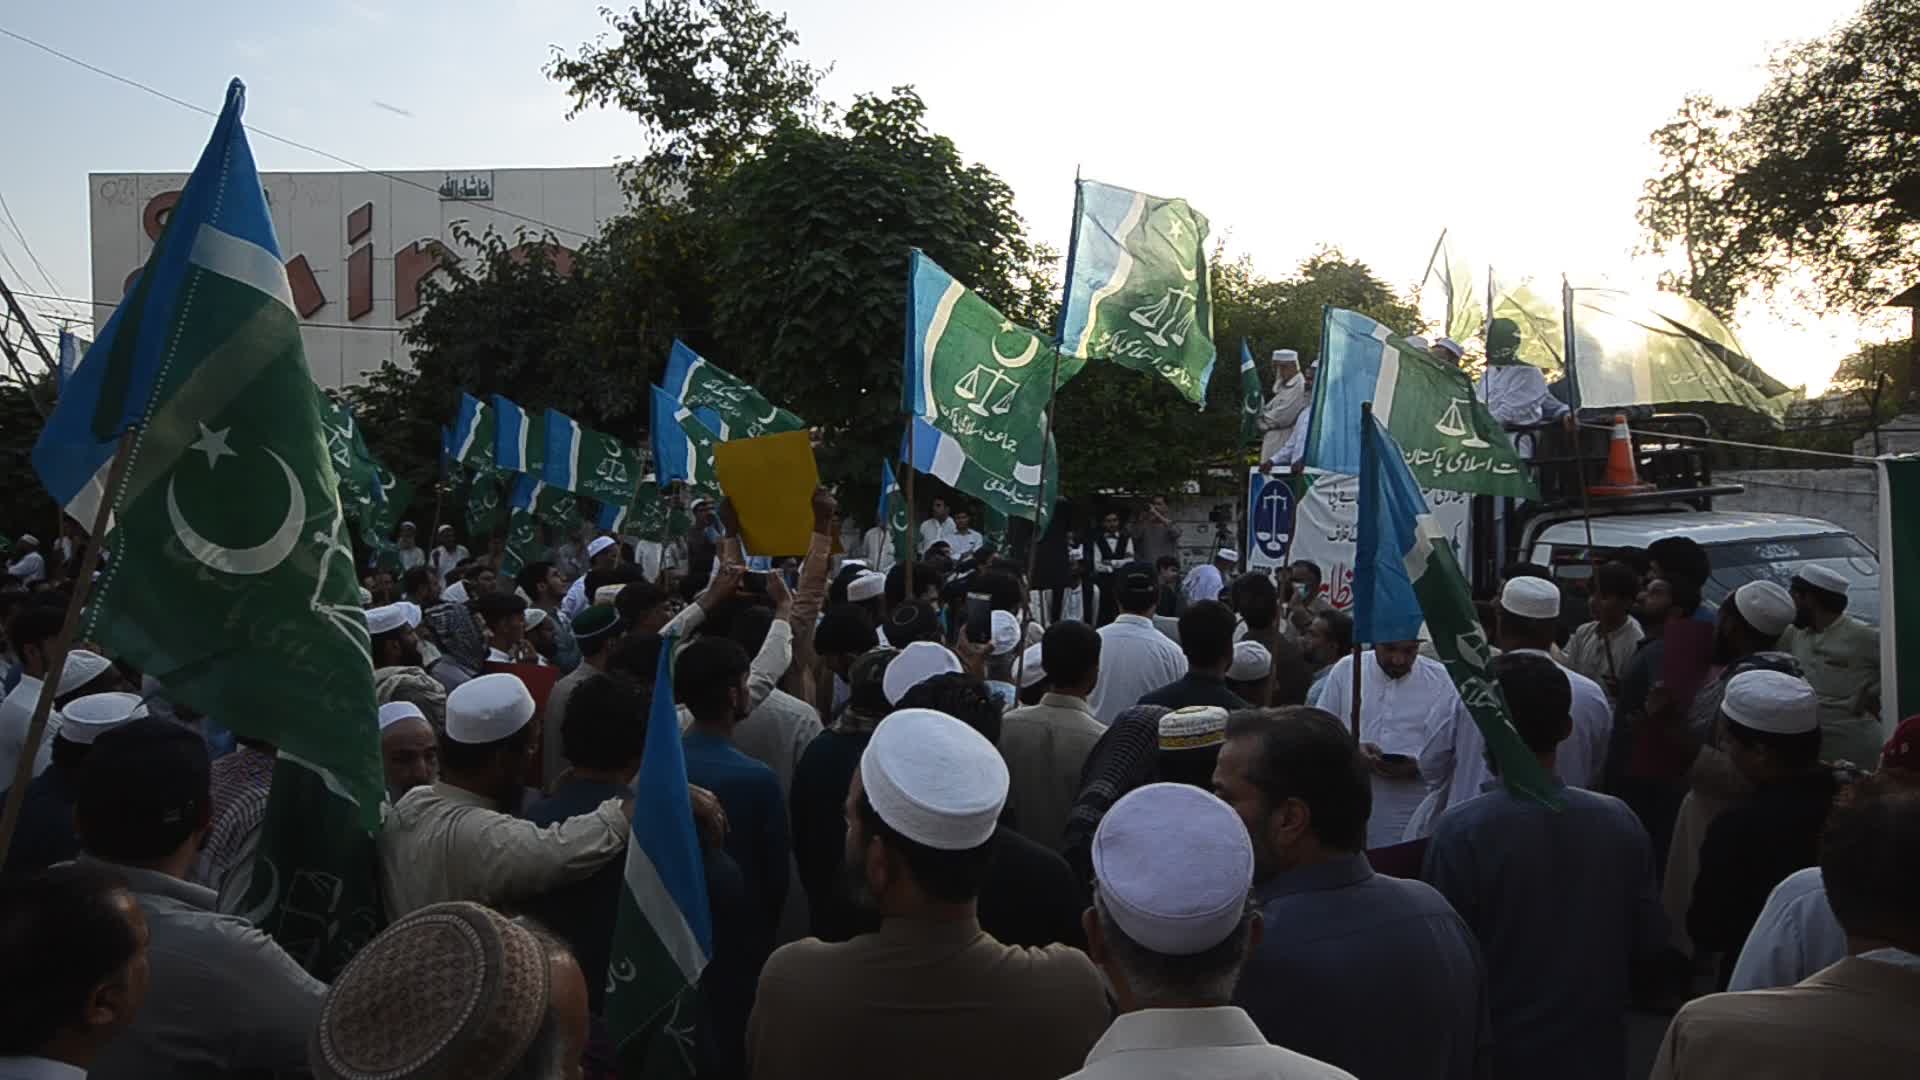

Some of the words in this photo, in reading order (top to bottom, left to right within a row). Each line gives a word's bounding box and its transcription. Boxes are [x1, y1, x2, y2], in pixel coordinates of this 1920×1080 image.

[983, 430, 1018, 453] جماعت
[1404, 446, 1447, 478] پاکستان
[1445, 451, 1493, 473] اسلامی
